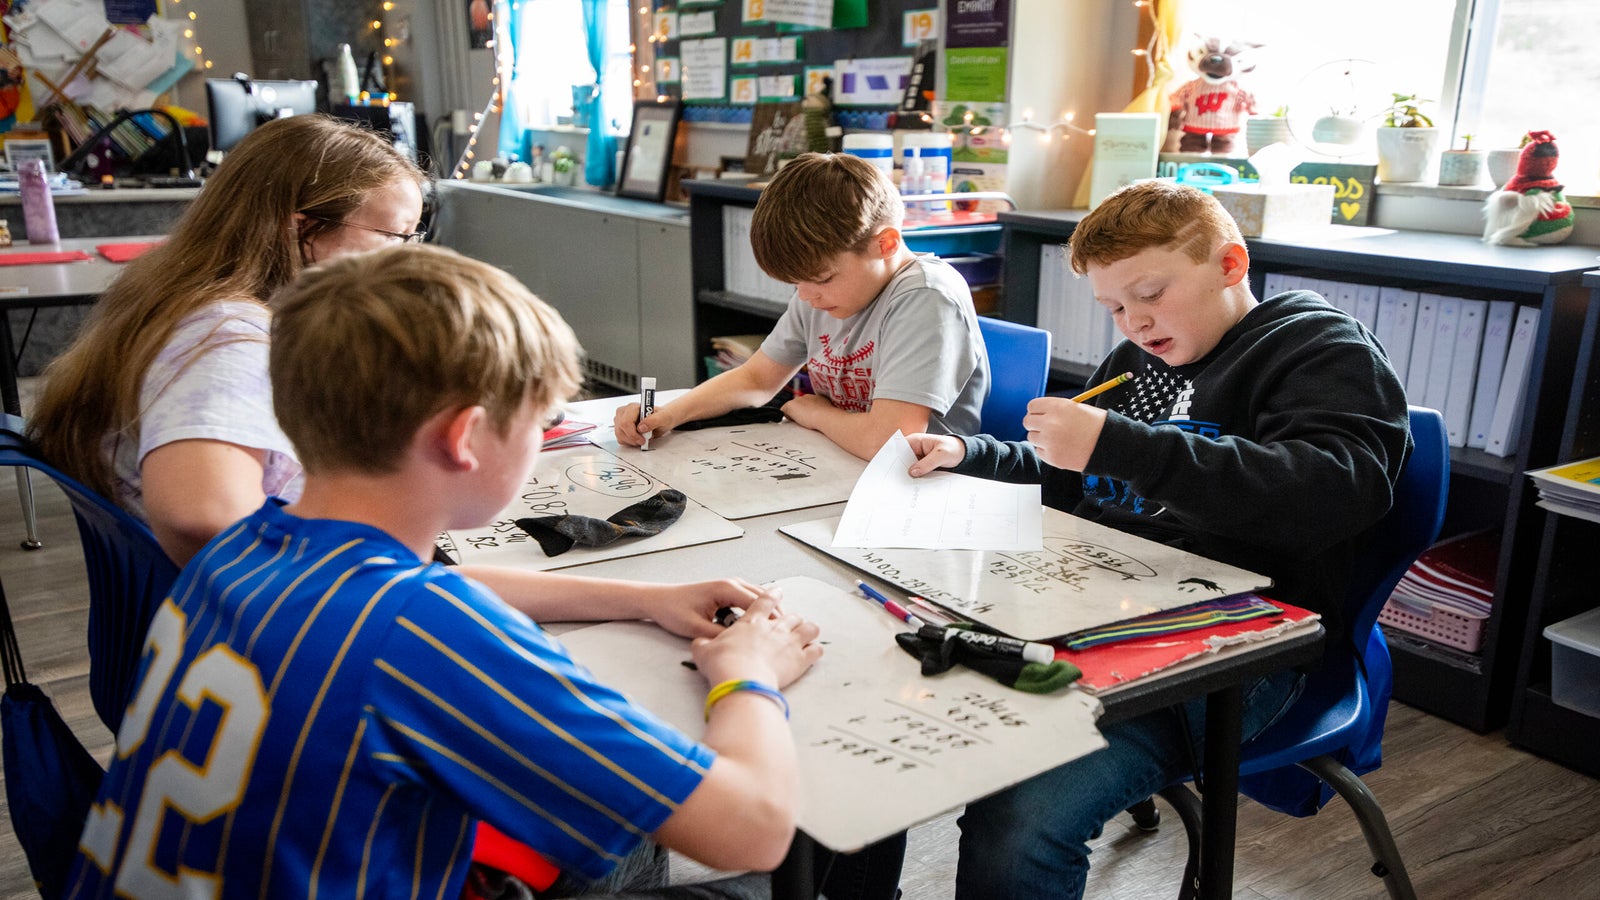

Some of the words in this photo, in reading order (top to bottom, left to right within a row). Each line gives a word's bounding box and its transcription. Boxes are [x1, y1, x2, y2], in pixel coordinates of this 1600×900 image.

[911, 14, 932, 39] 19
[735, 40, 752, 61] 14
[736, 79, 752, 101] 15
[1195, 92, 1229, 116] W
[959, 630, 997, 646] EXPO
